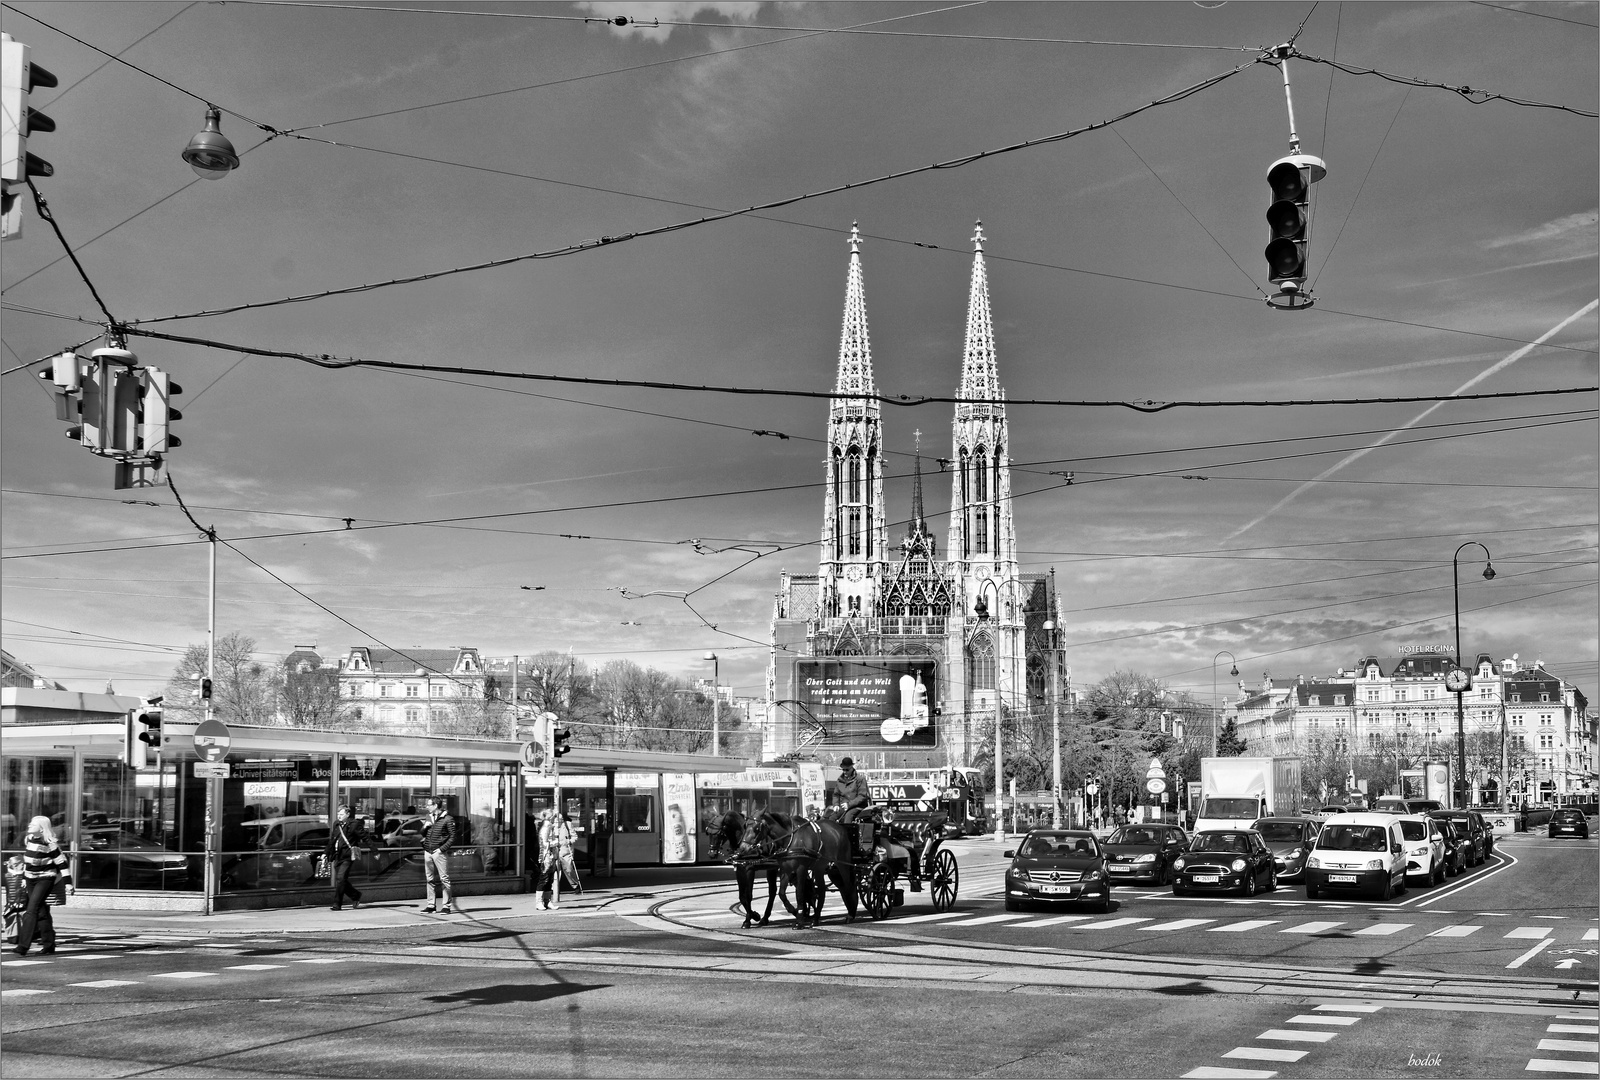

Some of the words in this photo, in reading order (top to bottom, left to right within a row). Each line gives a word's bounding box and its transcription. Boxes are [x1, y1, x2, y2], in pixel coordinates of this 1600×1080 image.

[1398, 645, 1424, 653] HOTEL
[1425, 644, 1455, 652] REGINA
[806, 677, 824, 686] Über
[825, 678, 842, 686] Gott
[844, 678, 858, 686] und
[860, 678, 872, 686] die
[874, 678, 892, 686] Welt
[821, 697, 833, 705] bei
[239, 769, 298, 778] Universitätsring
[247, 784, 277, 795] Eisen
[868, 787, 907, 799] IENNA
